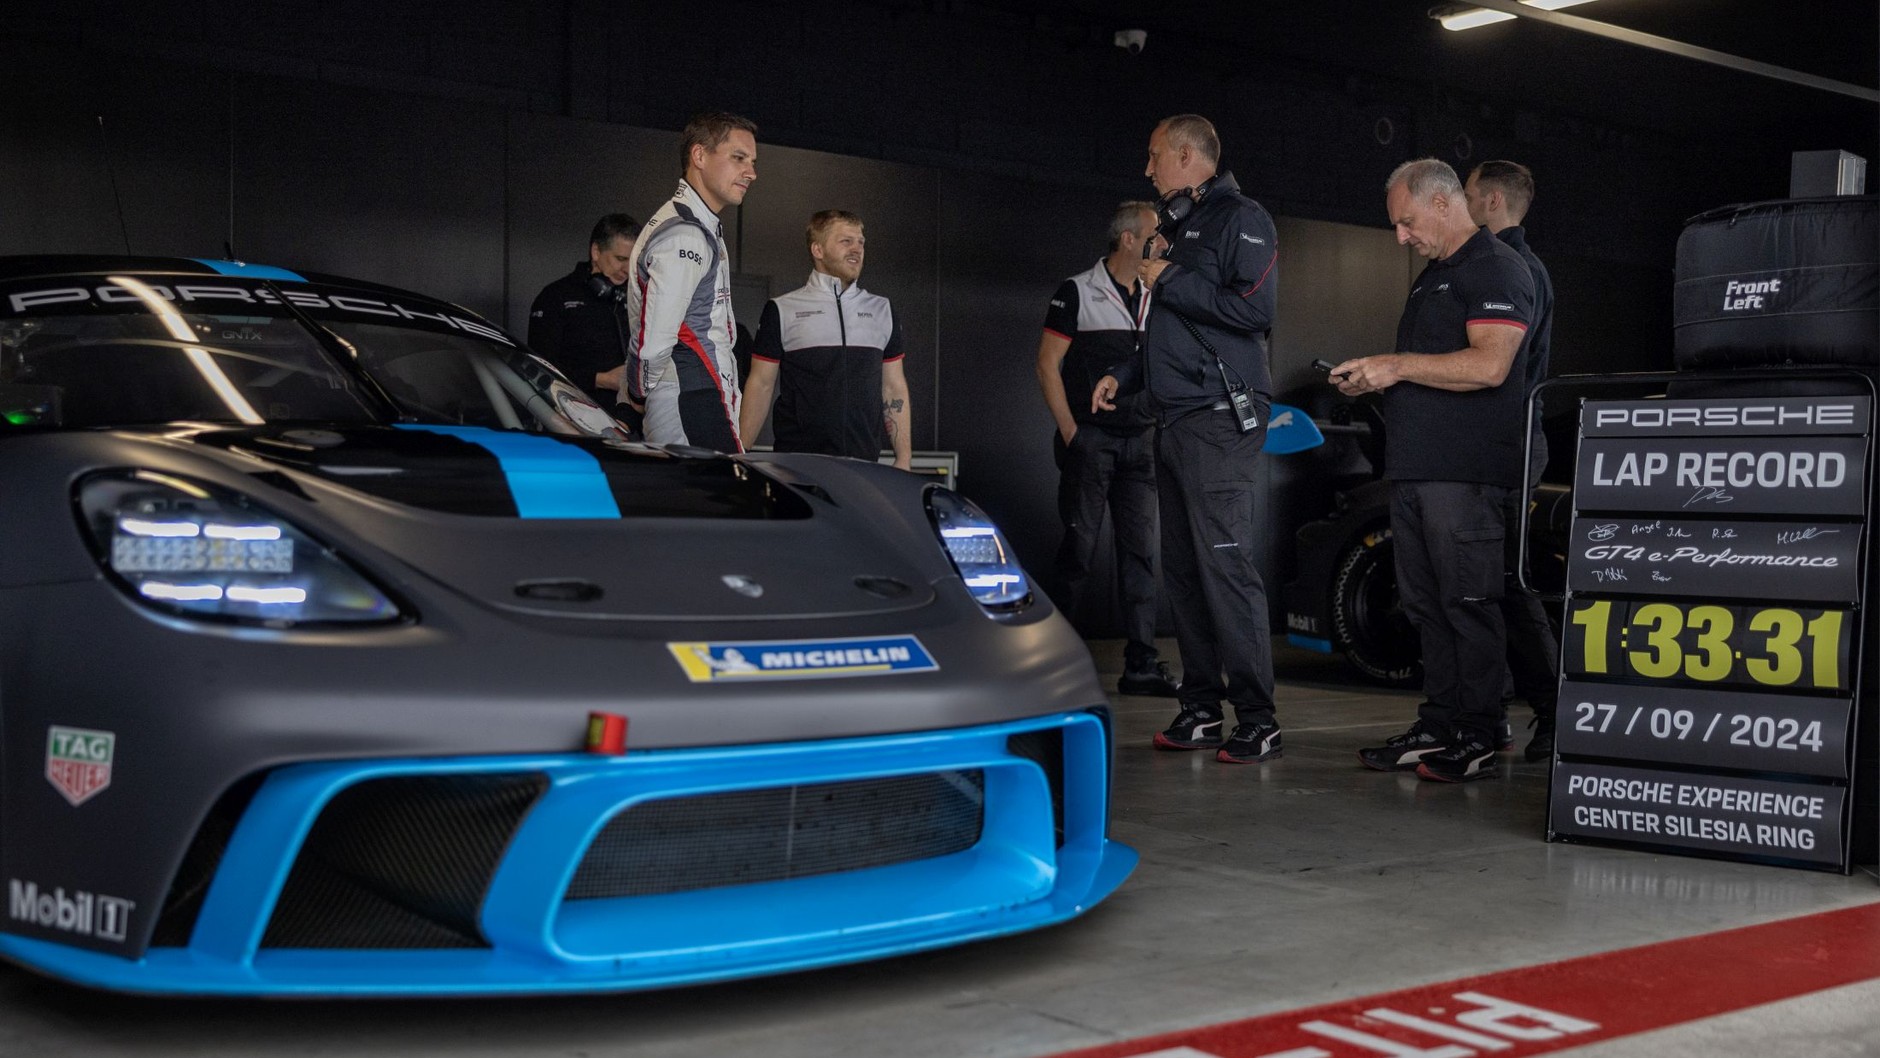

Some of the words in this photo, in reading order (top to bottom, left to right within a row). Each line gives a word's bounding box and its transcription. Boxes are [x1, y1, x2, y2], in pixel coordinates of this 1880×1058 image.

[679, 249, 702, 266] BOSS
[1726, 279, 1781, 295] Front
[9, 285, 518, 346] PORSCHE
[1723, 295, 1763, 311] Left
[1596, 405, 1854, 427] PORSCHE
[1593, 452, 1668, 486] LAP
[1676, 452, 1846, 488] RECORD
[1585, 545, 1645, 560] GT4
[1648, 547, 1839, 568] e-Performance
[761, 647, 911, 668] MICHELIN
[1575, 702, 1617, 733] 27
[1650, 708, 1694, 740] 09
[1730, 715, 1823, 752] 2024
[55, 734, 107, 760] TAG
[49, 759, 110, 797] HEUER
[1568, 775, 1673, 804] PORSCHE
[1677, 786, 1824, 819] EXPERIENCE
[1574, 806, 1660, 834] CENTER
[1665, 816, 1752, 844] SILESIA
[1756, 825, 1815, 850] RING
[9, 878, 94, 935] Mobil
